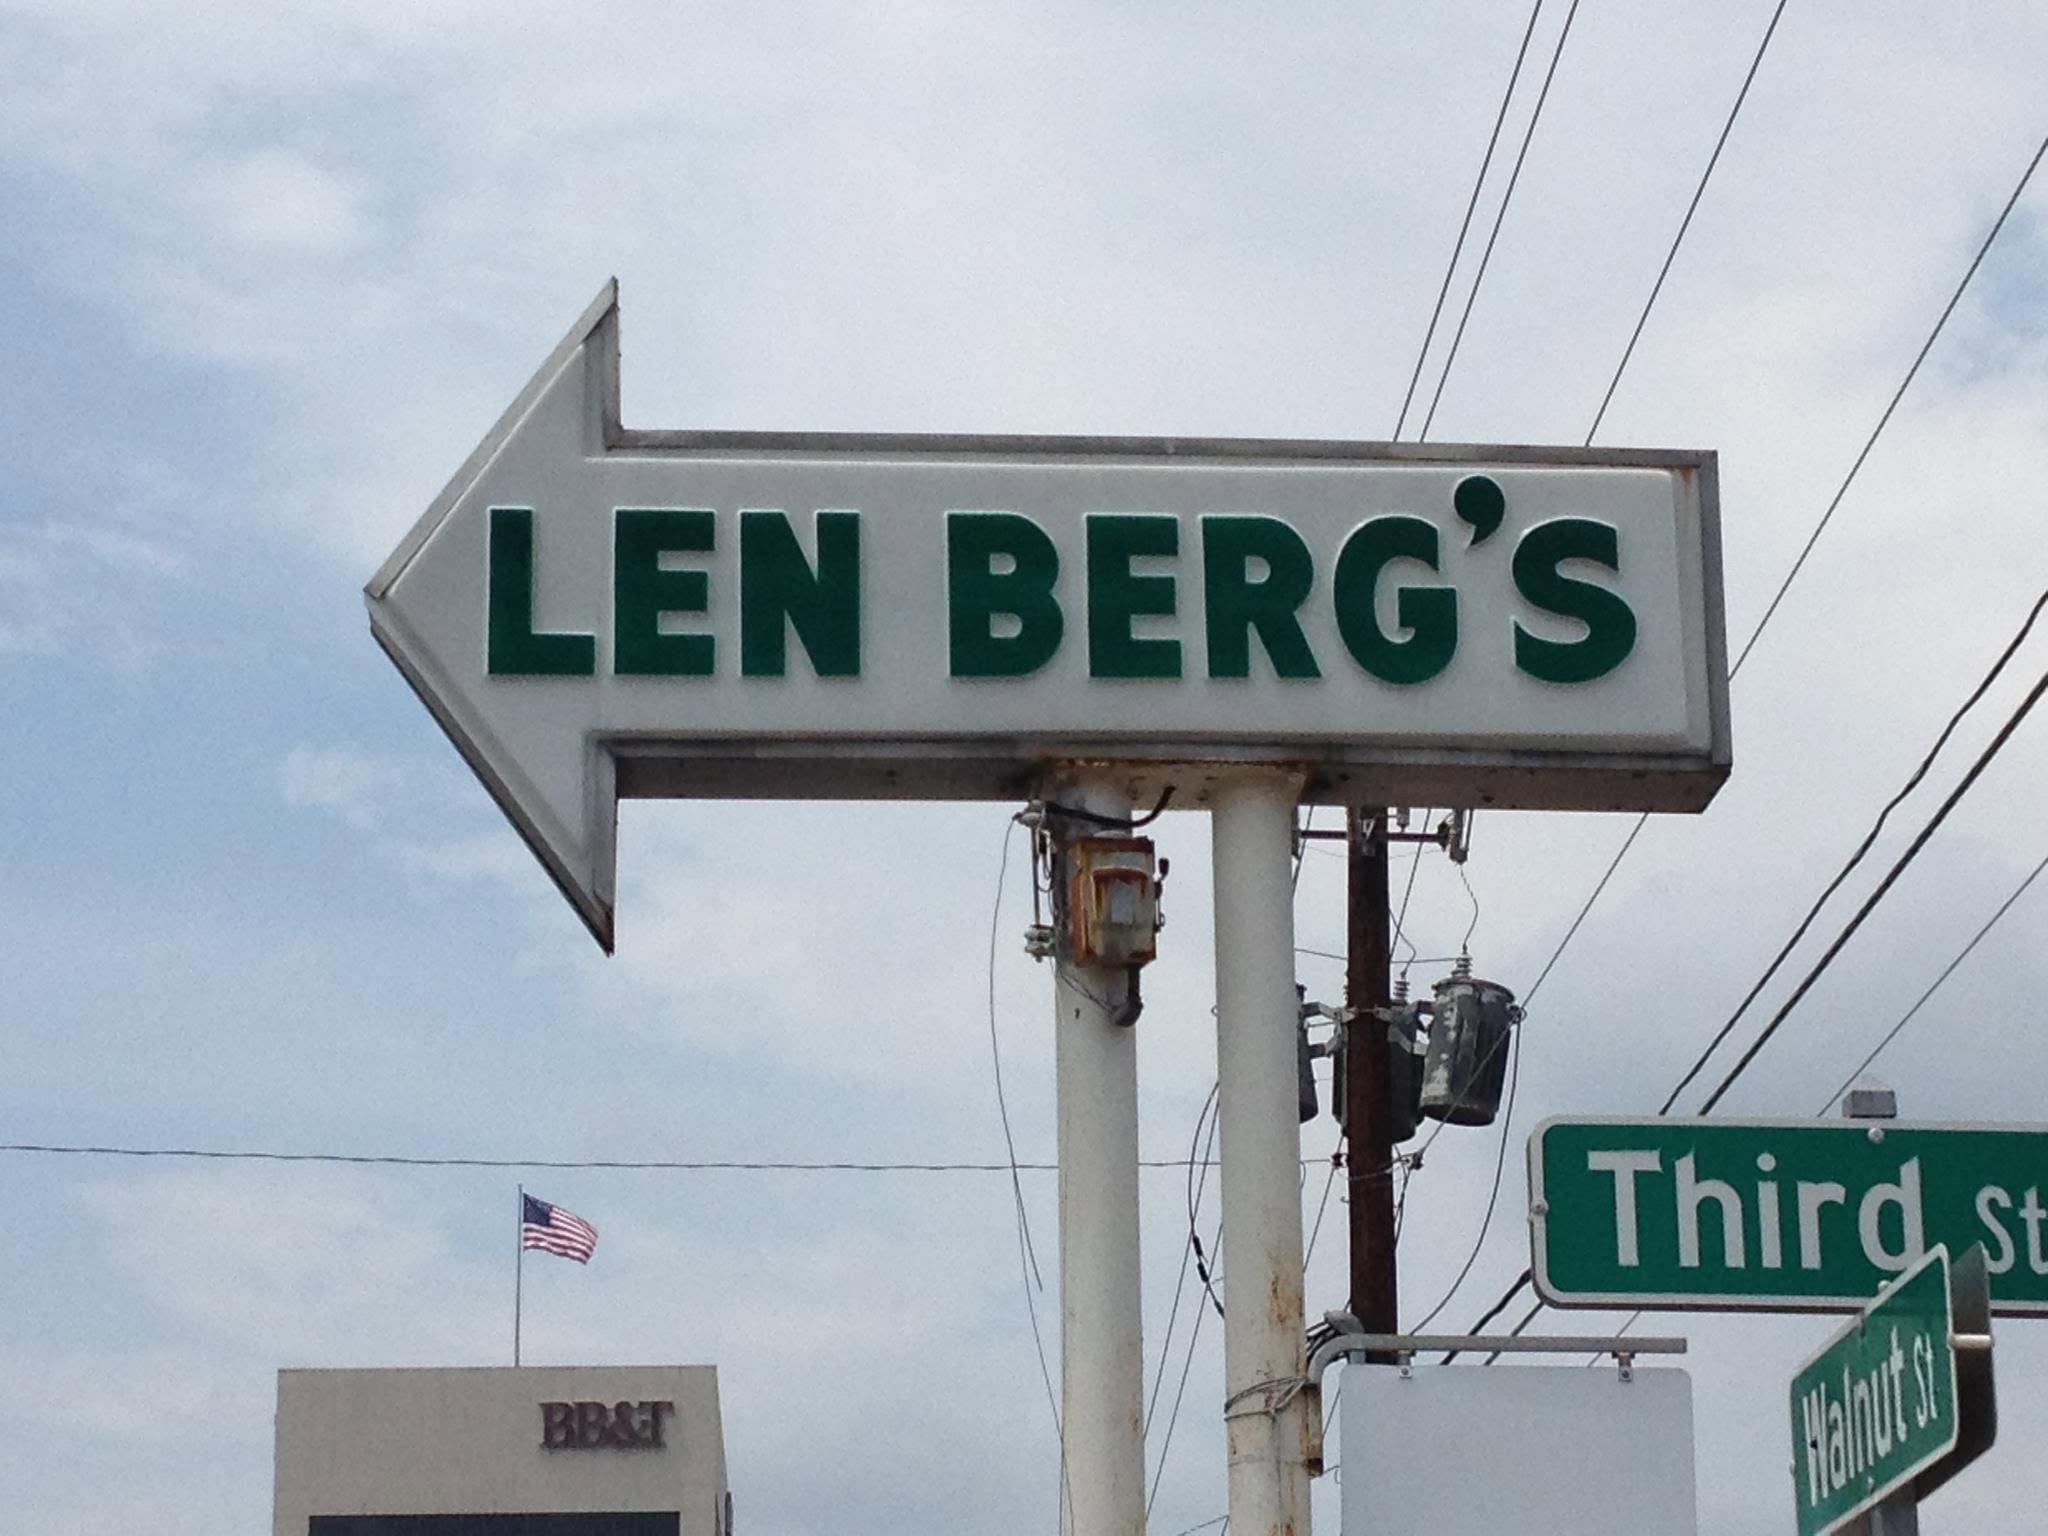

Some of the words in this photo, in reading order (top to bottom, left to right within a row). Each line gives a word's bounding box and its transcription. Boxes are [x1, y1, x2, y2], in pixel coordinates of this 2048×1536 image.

[487, 508, 860, 678] LEN
[947, 474, 1638, 684] BERG'S
[1586, 1150, 1926, 1273] Third
[539, 1400, 675, 1449] BB&T
[1802, 1324, 1906, 1506] Walnut
[1912, 1333, 1938, 1428] St
